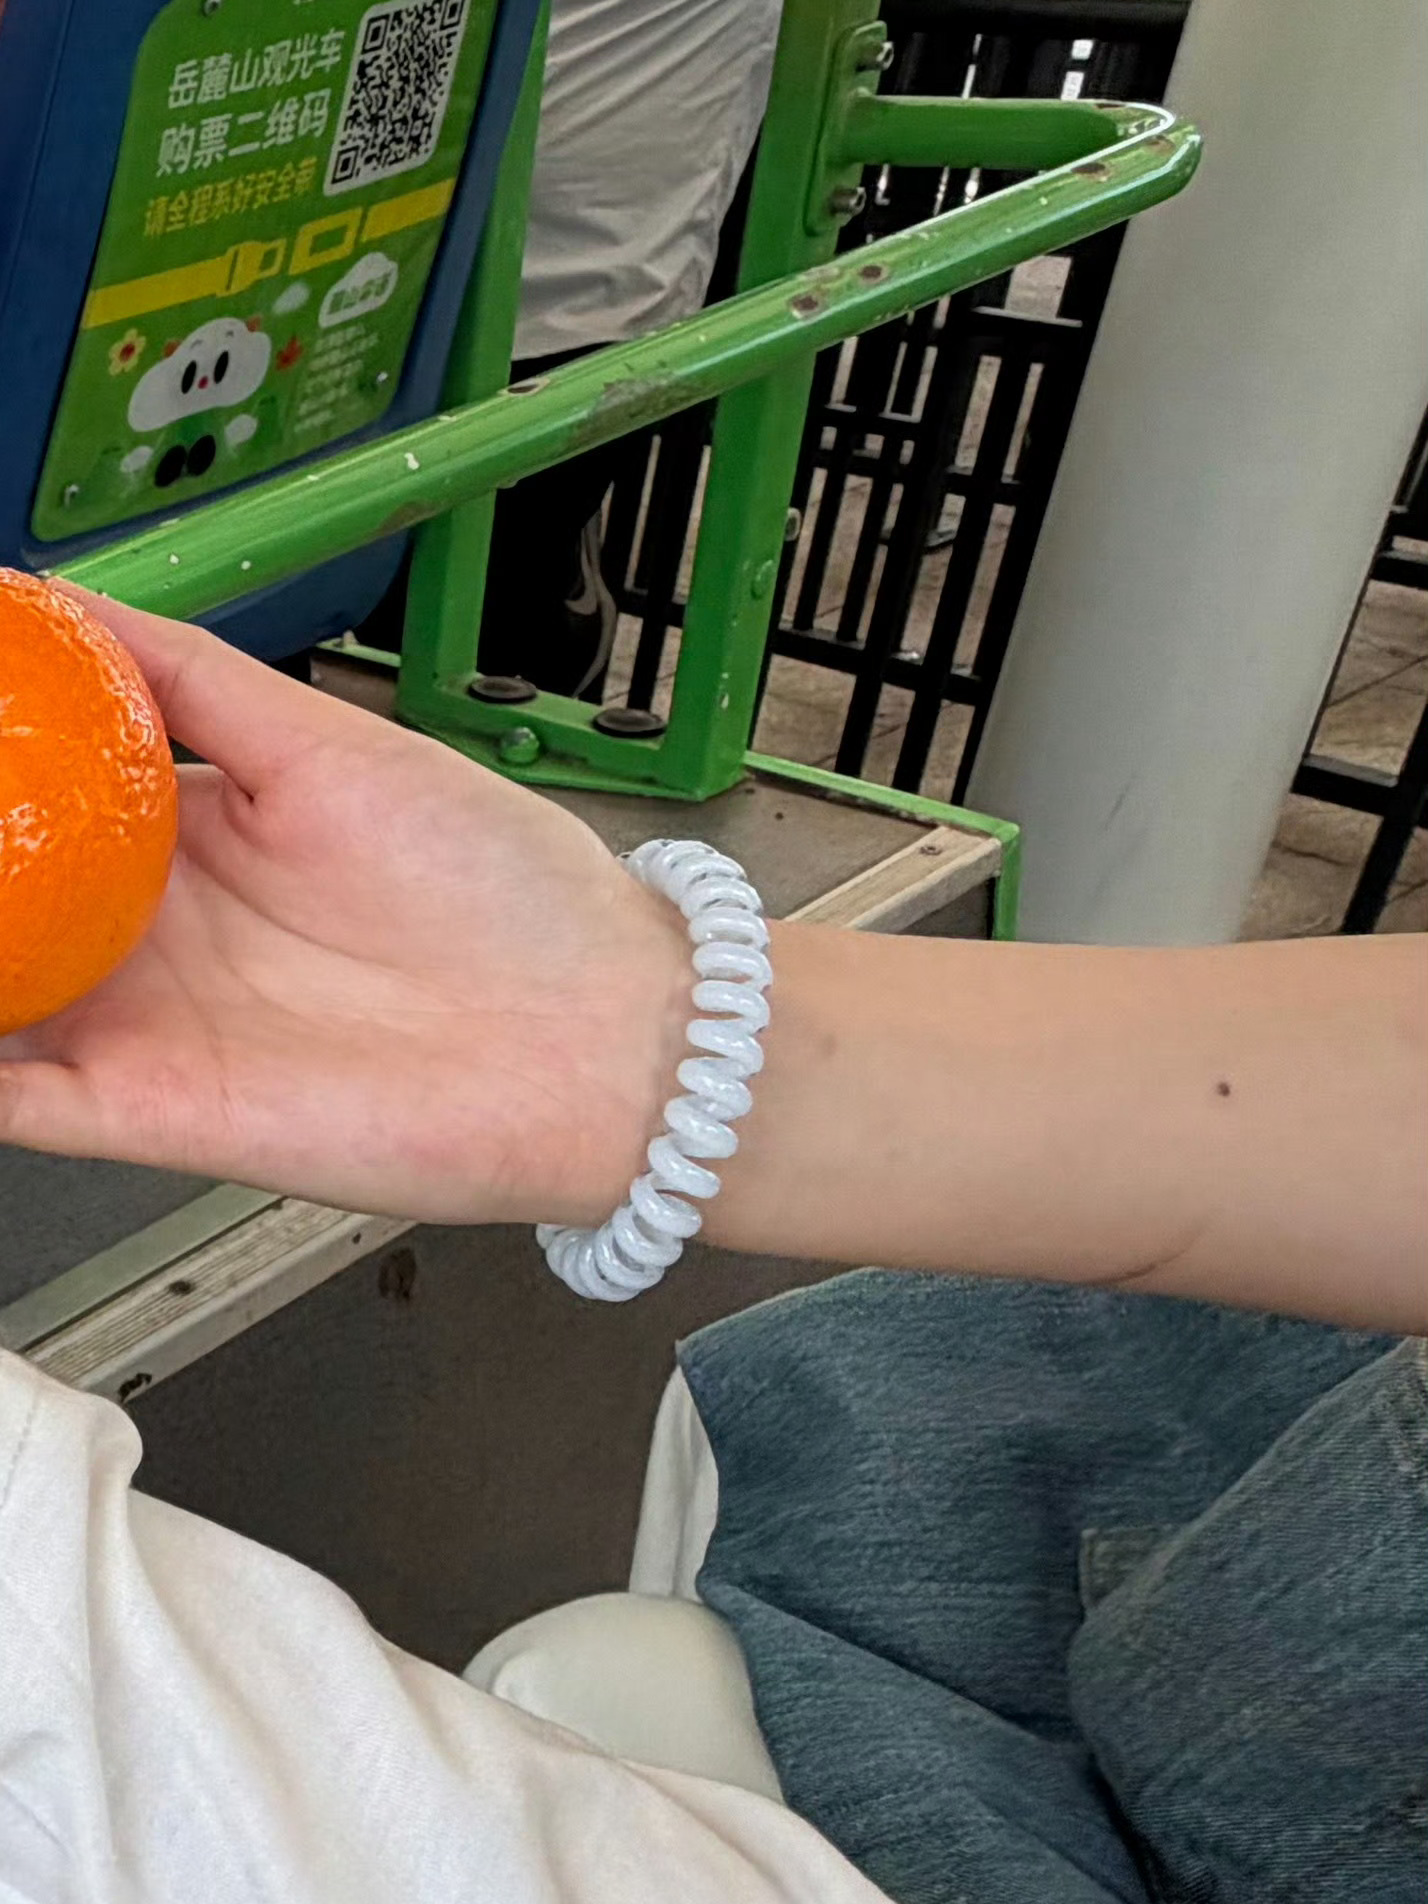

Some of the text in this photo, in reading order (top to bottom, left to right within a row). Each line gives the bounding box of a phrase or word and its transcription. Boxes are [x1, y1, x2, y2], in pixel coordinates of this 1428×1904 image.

[168, 27, 346, 109] 岳麓山观光车
[156, 87, 332, 178] 购票二维码
